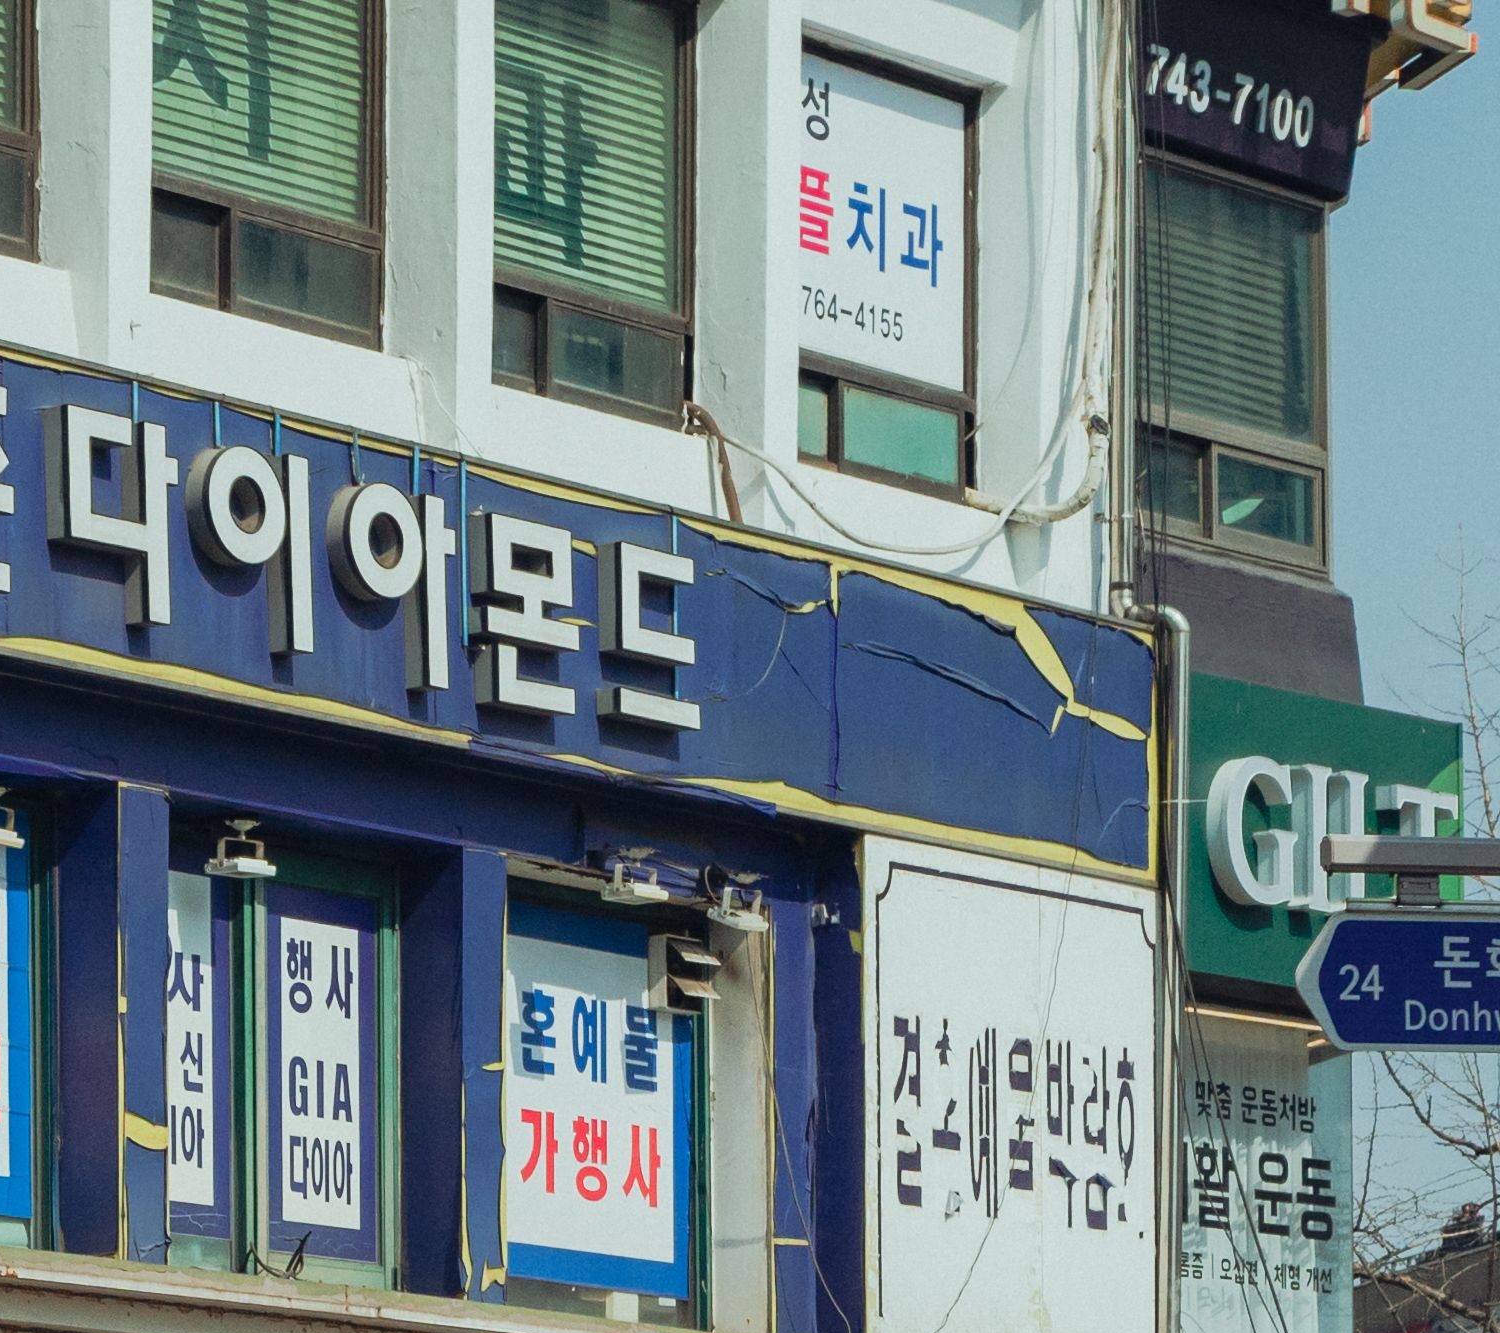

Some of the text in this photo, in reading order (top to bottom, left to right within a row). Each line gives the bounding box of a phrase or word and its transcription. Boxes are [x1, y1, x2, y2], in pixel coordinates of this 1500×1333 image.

[1147, 43, 1315, 149] 743-7100
[801, 285, 905, 342] 764-4155
[1338, 963, 1385, 1002] 24
[288, 1055, 353, 1123] GIA
[1194, 1080, 1317, 1134] 맞춤 운동처방
[289, 1135, 353, 1206] 다이아
[520, 1107, 661, 1209] 가행사
[1182, 1141, 1337, 1242] 활 운동
[1273, 1264, 1301, 1291] 체형
[1305, 1266, 1333, 1294] 개선
